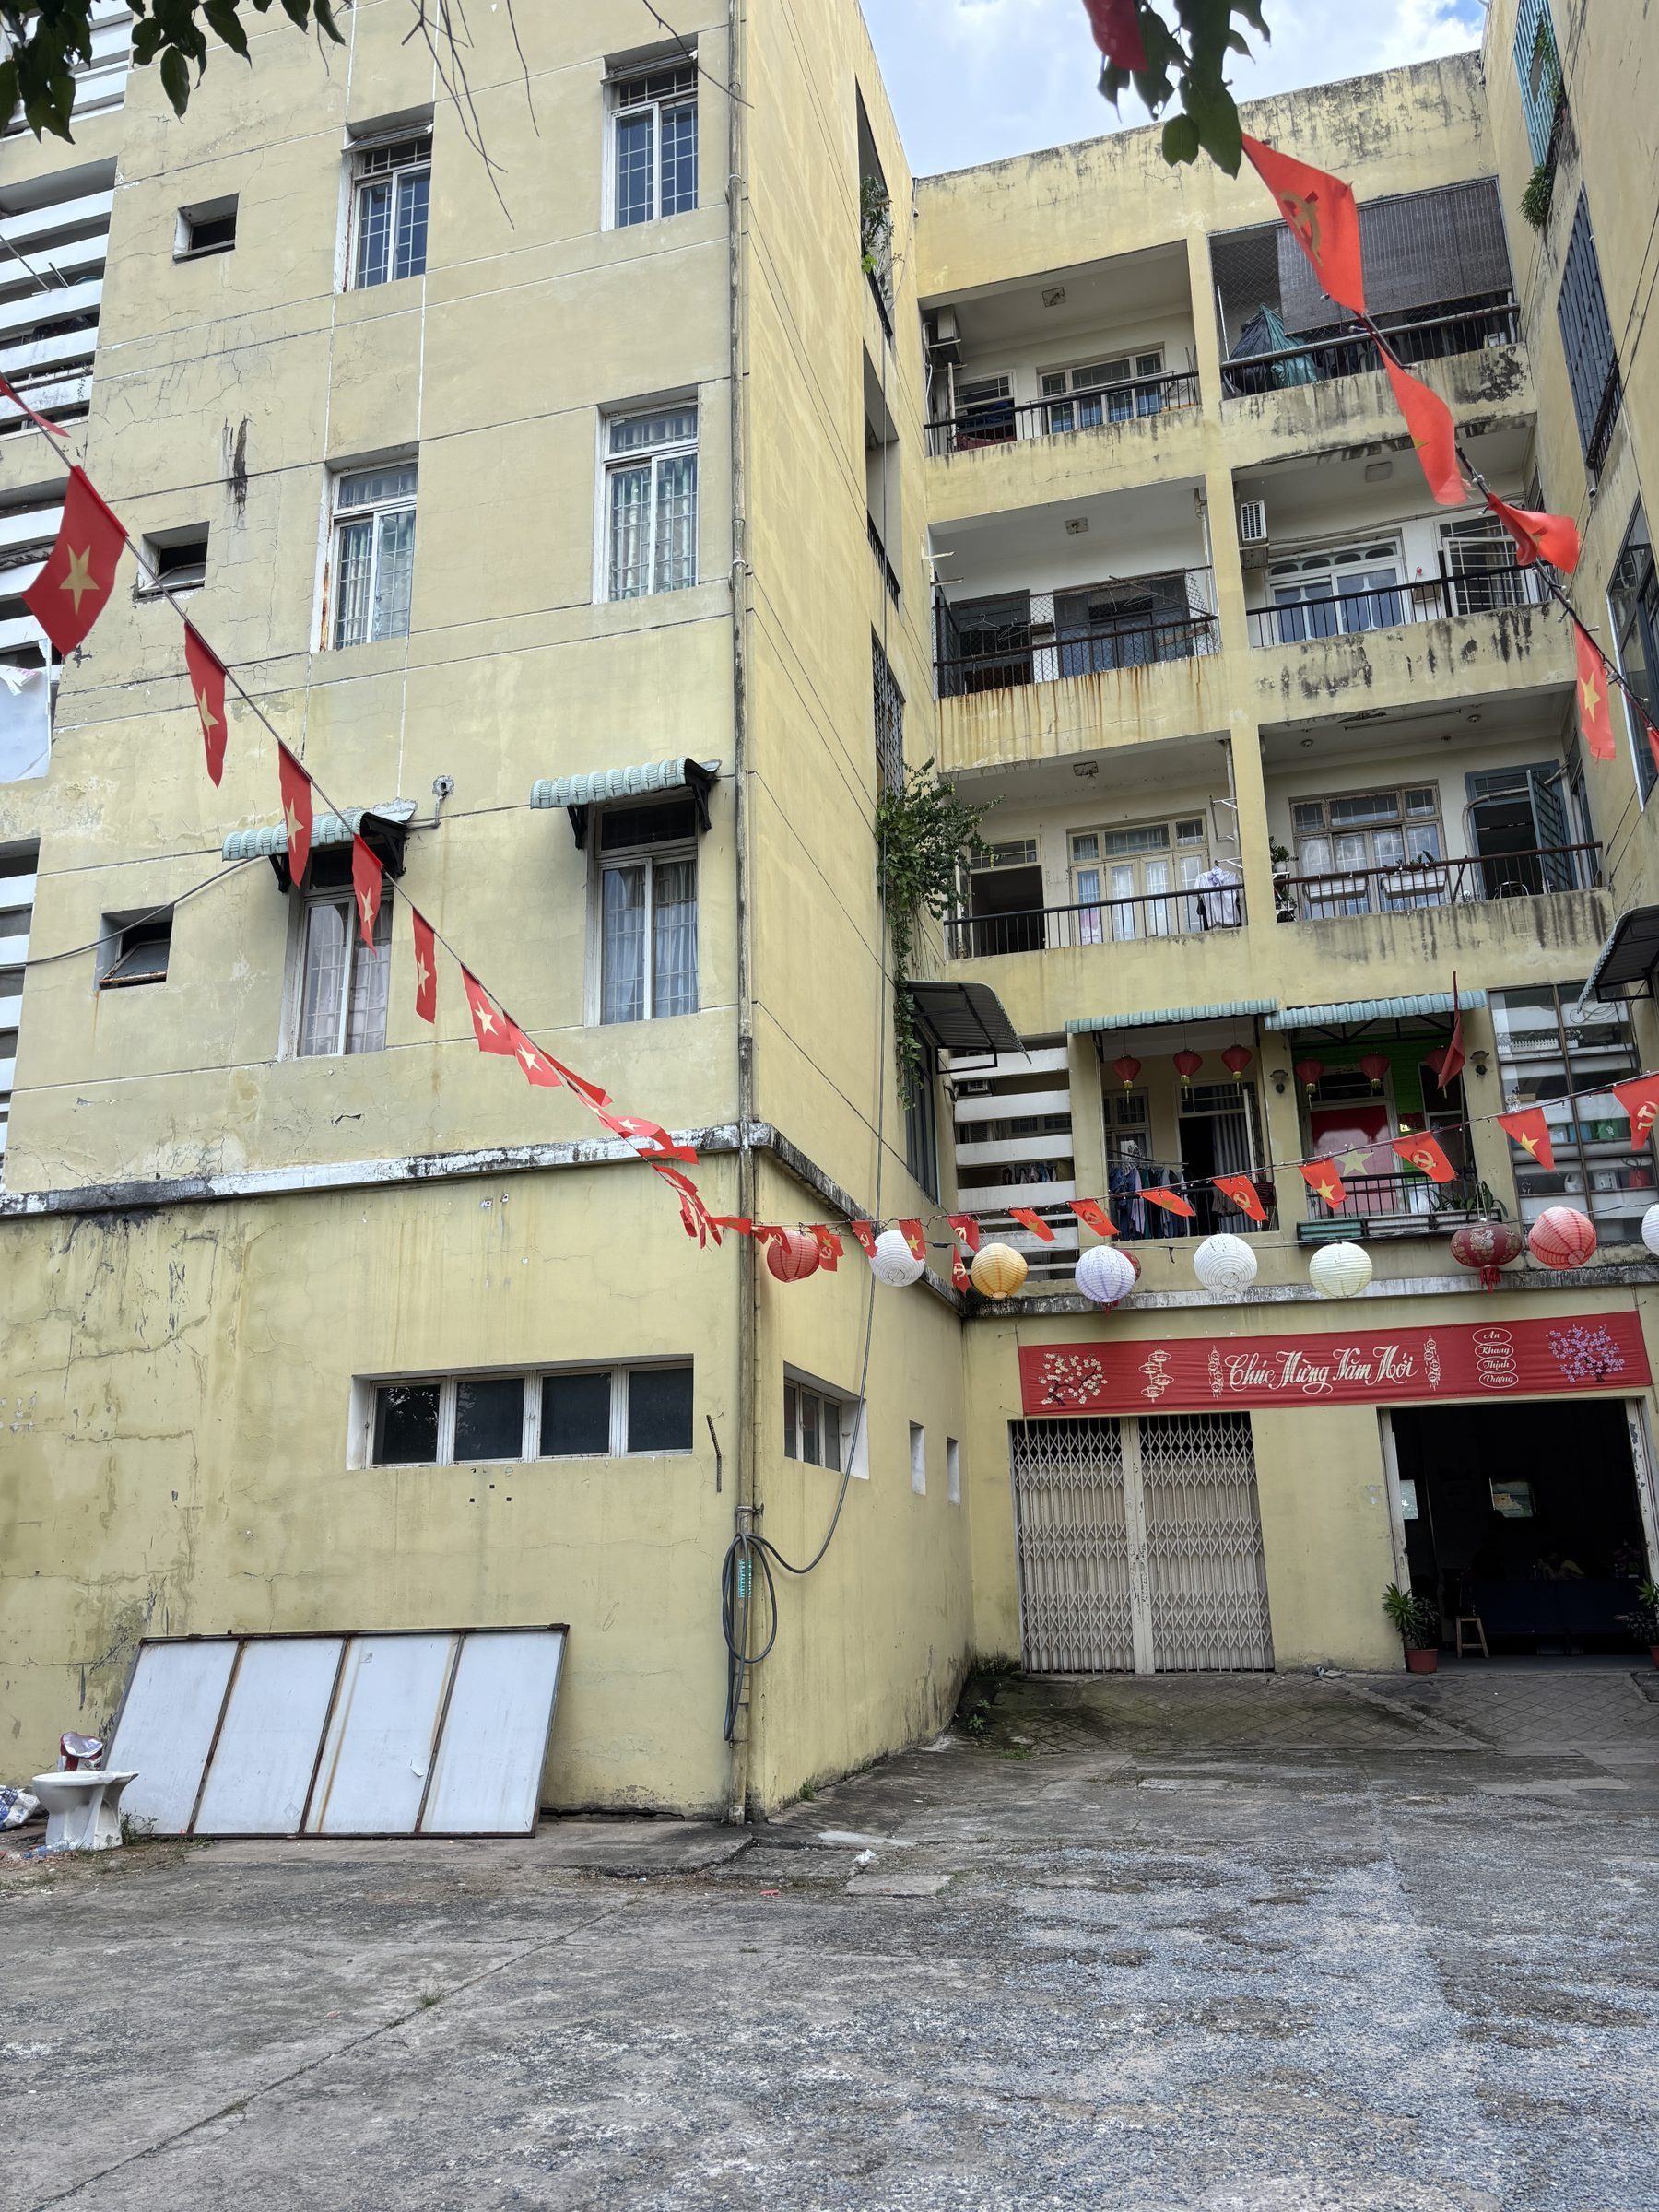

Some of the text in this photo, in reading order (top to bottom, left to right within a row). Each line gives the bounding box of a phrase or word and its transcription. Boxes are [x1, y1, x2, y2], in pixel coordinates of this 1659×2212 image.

[1483, 1331, 1500, 1339] An
[1478, 1346, 1510, 1355] Khang
[1224, 1352, 1276, 1391] Chúc
[1268, 1350, 1333, 1394] Mừng
[1332, 1347, 1372, 1381] Năm
[1365, 1345, 1418, 1386] Mới
[1483, 1359, 1510, 1371] Thịnh
[1483, 1374, 1513, 1384] Vượng
